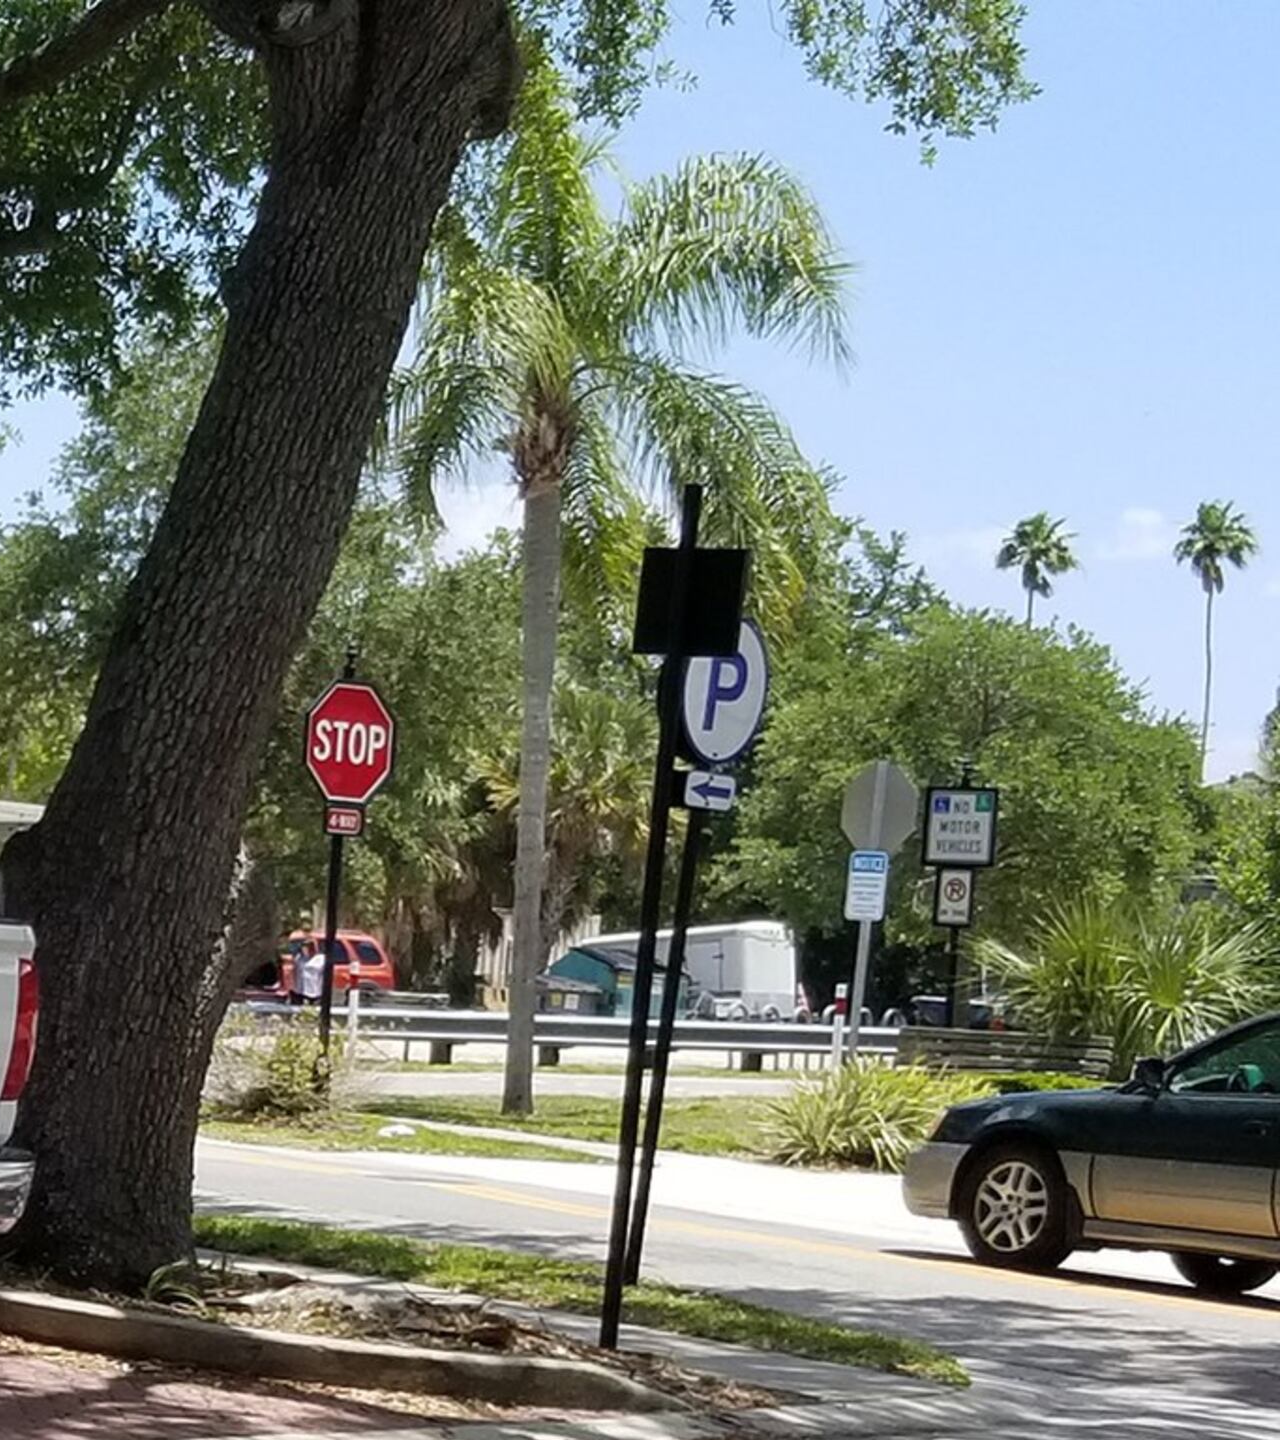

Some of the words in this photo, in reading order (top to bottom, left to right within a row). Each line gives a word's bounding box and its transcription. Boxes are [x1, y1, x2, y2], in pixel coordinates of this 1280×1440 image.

[702, 652, 749, 731] P
[313, 719, 386, 766] STOP
[954, 801, 970, 814] NO
[940, 820, 981, 834] MOTOR
[936, 840, 982, 854] VEHICLES
